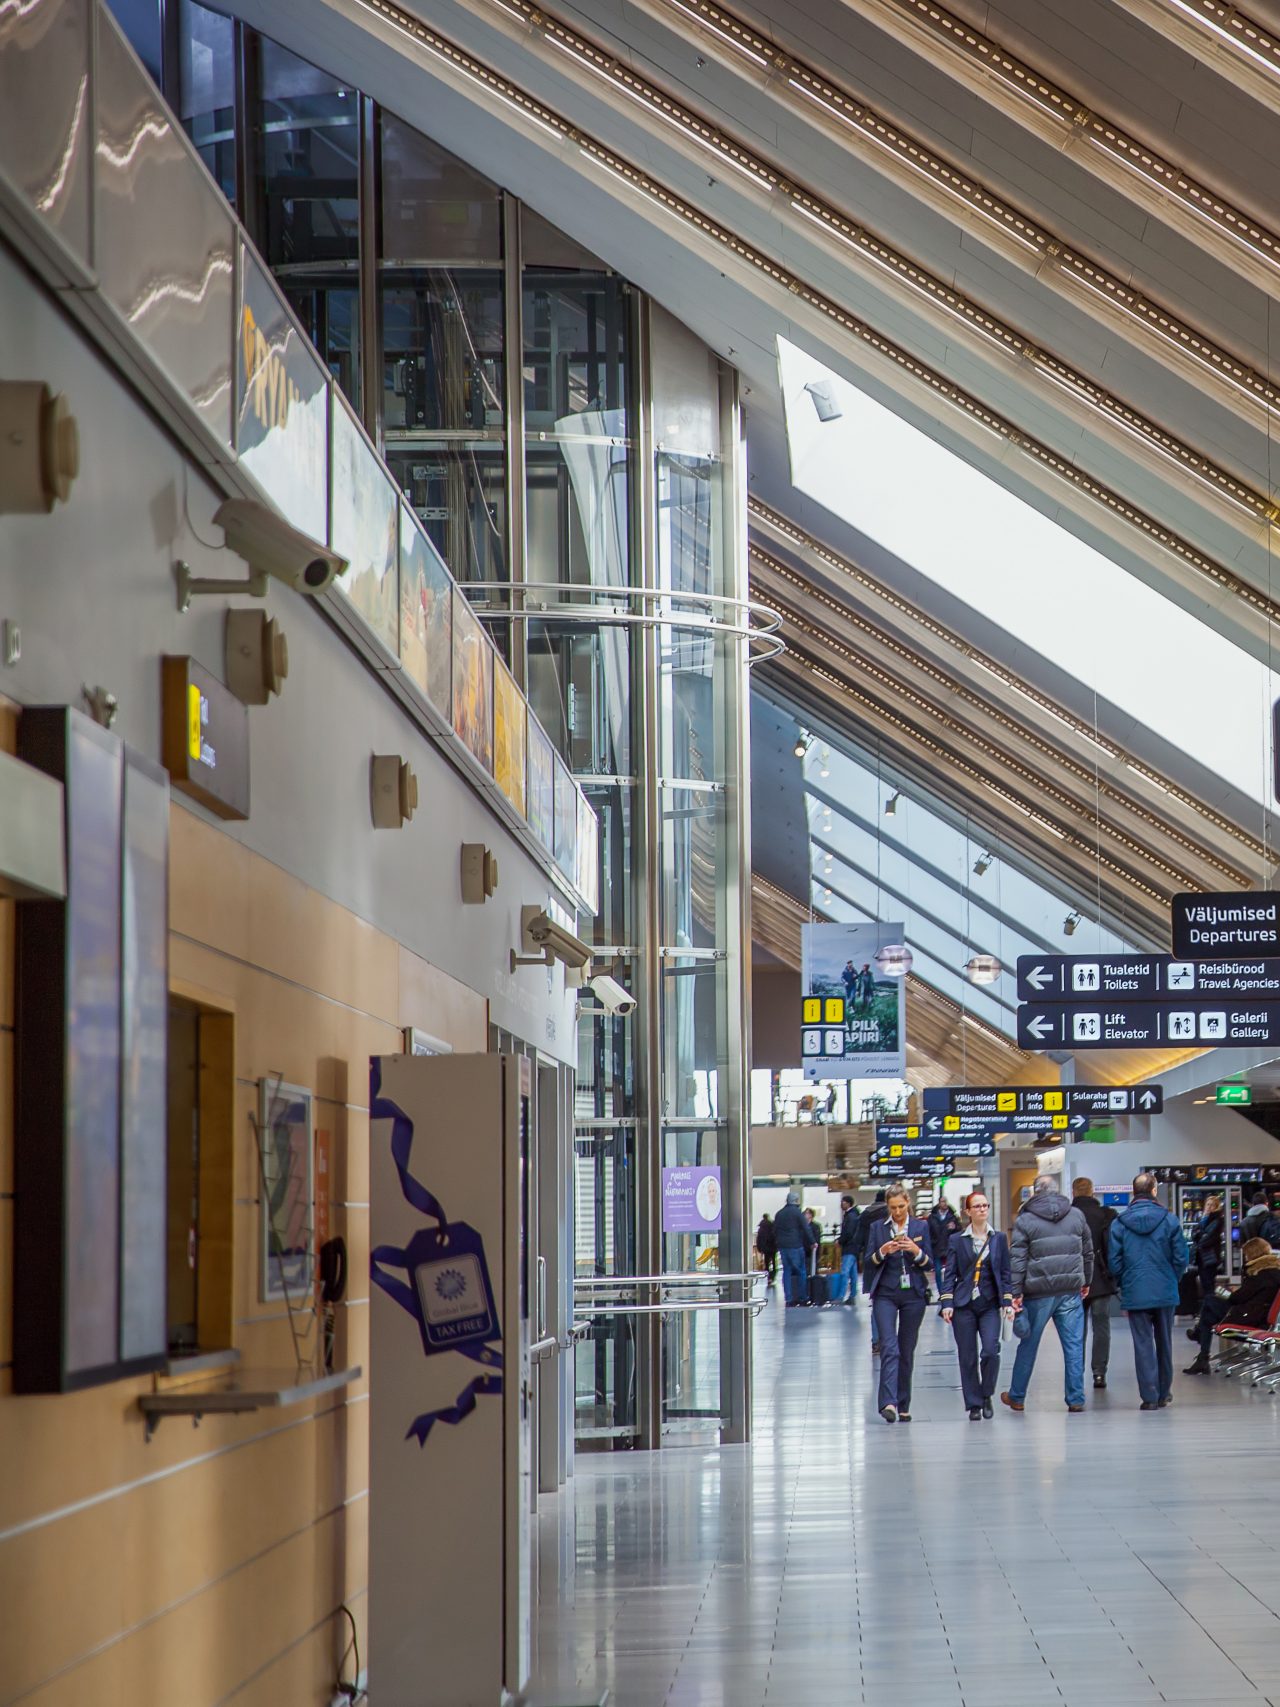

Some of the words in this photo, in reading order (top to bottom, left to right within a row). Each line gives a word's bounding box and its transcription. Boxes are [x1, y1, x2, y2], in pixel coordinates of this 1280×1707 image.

[1185, 905, 1275, 924] Väljumised
[1191, 929, 1276, 945] Departures
[1103, 964, 1149, 975] Tualetid
[1199, 963, 1264, 974] Reisibürood
[1104, 980, 1138, 989] Toilets
[1199, 978, 1230, 988] Travel
[1233, 978, 1279, 990] Agencies
[1105, 1014, 1125, 1024] Lift
[1231, 1012, 1267, 1023] Galerii
[852, 1020, 879, 1030] PILK
[1105, 1029, 1149, 1039] Elevator
[1231, 1027, 1268, 1039] Gallery
[955, 1094, 996, 1103] Väljumised
[1073, 1092, 1107, 1100] Sularaha
[957, 1104, 996, 1112] Departures
[436, 1324, 456, 1336] TAX
[457, 1318, 483, 1332] FREE
